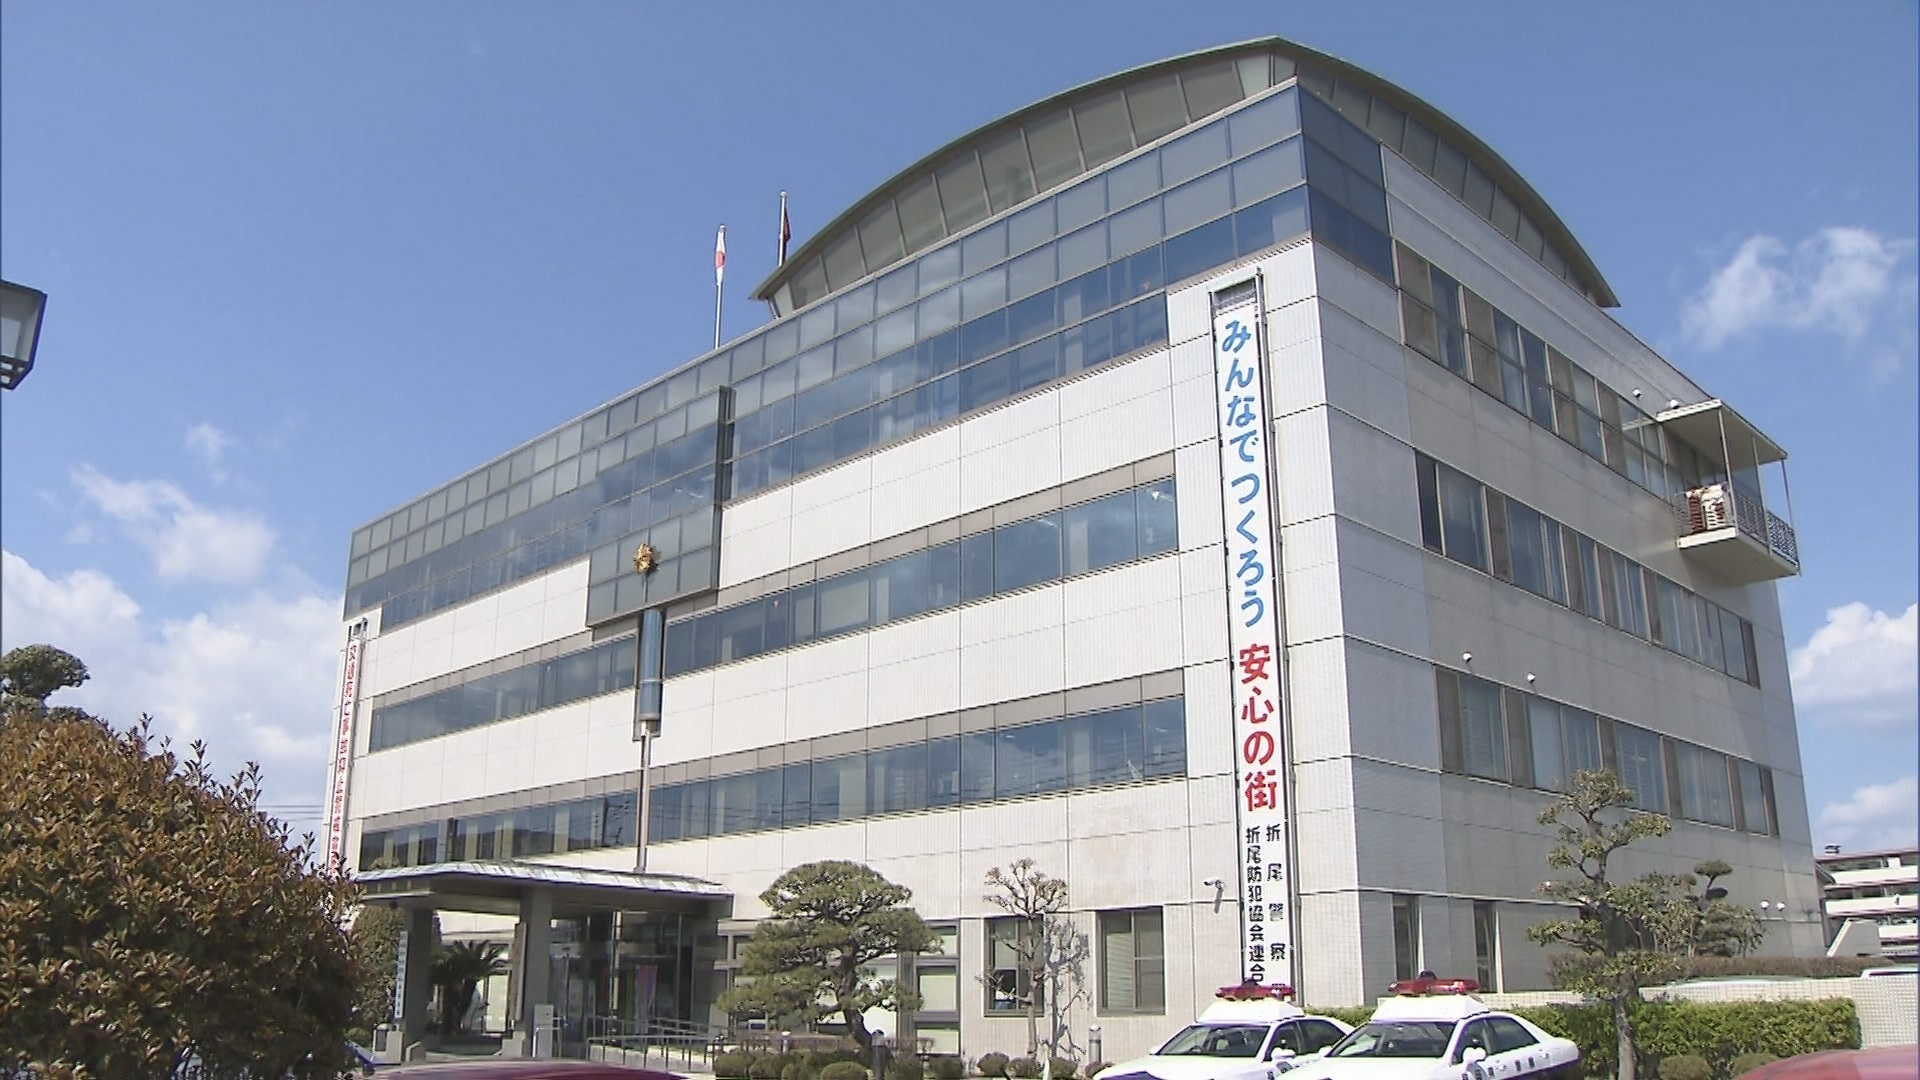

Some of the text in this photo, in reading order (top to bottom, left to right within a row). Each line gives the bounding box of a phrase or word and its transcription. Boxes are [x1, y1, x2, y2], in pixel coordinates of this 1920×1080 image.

[1222, 319, 1277, 812] みんなでつくろう 安心の街
[1266, 822, 1286, 986] 折尾警察
